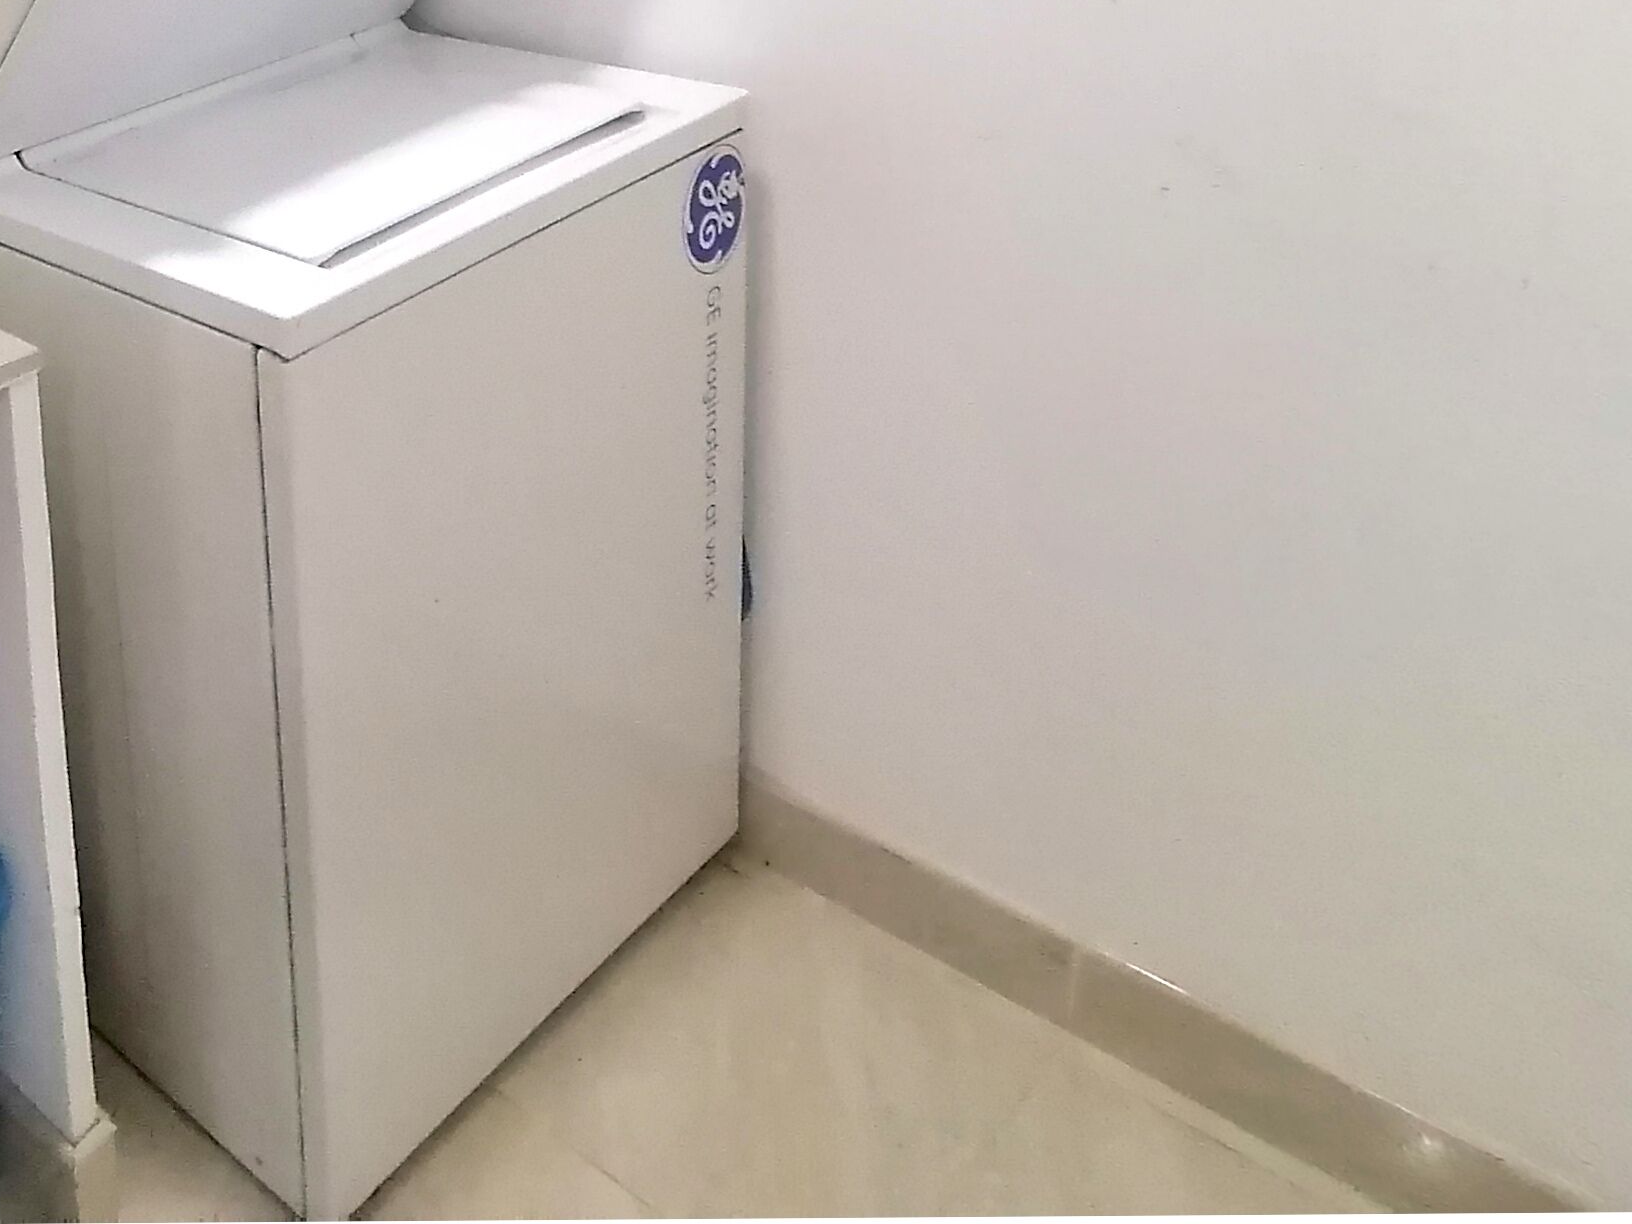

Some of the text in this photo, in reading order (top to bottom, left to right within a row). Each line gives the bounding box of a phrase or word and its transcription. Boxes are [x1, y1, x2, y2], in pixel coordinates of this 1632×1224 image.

[703, 286, 721, 602] GE imagination at work
